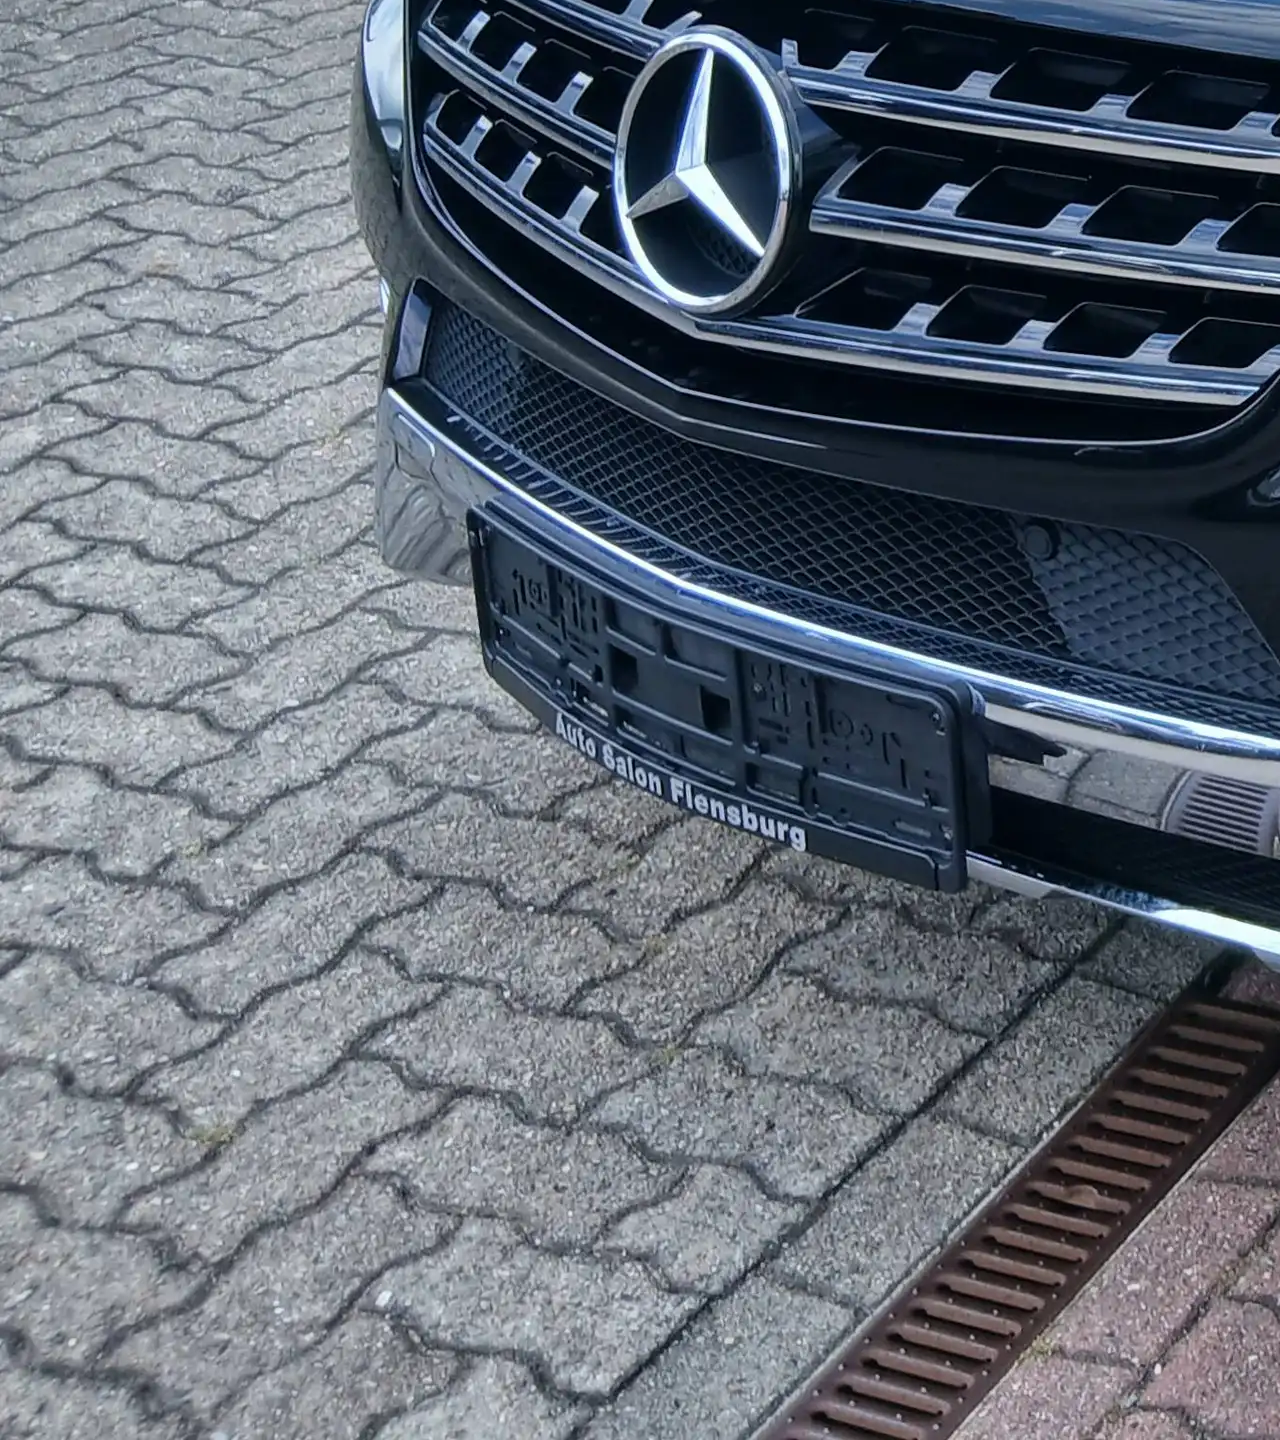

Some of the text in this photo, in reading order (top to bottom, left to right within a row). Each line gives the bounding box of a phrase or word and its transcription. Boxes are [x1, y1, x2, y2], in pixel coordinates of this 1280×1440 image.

[556, 712, 807, 852] Auto Salon Flensburg
